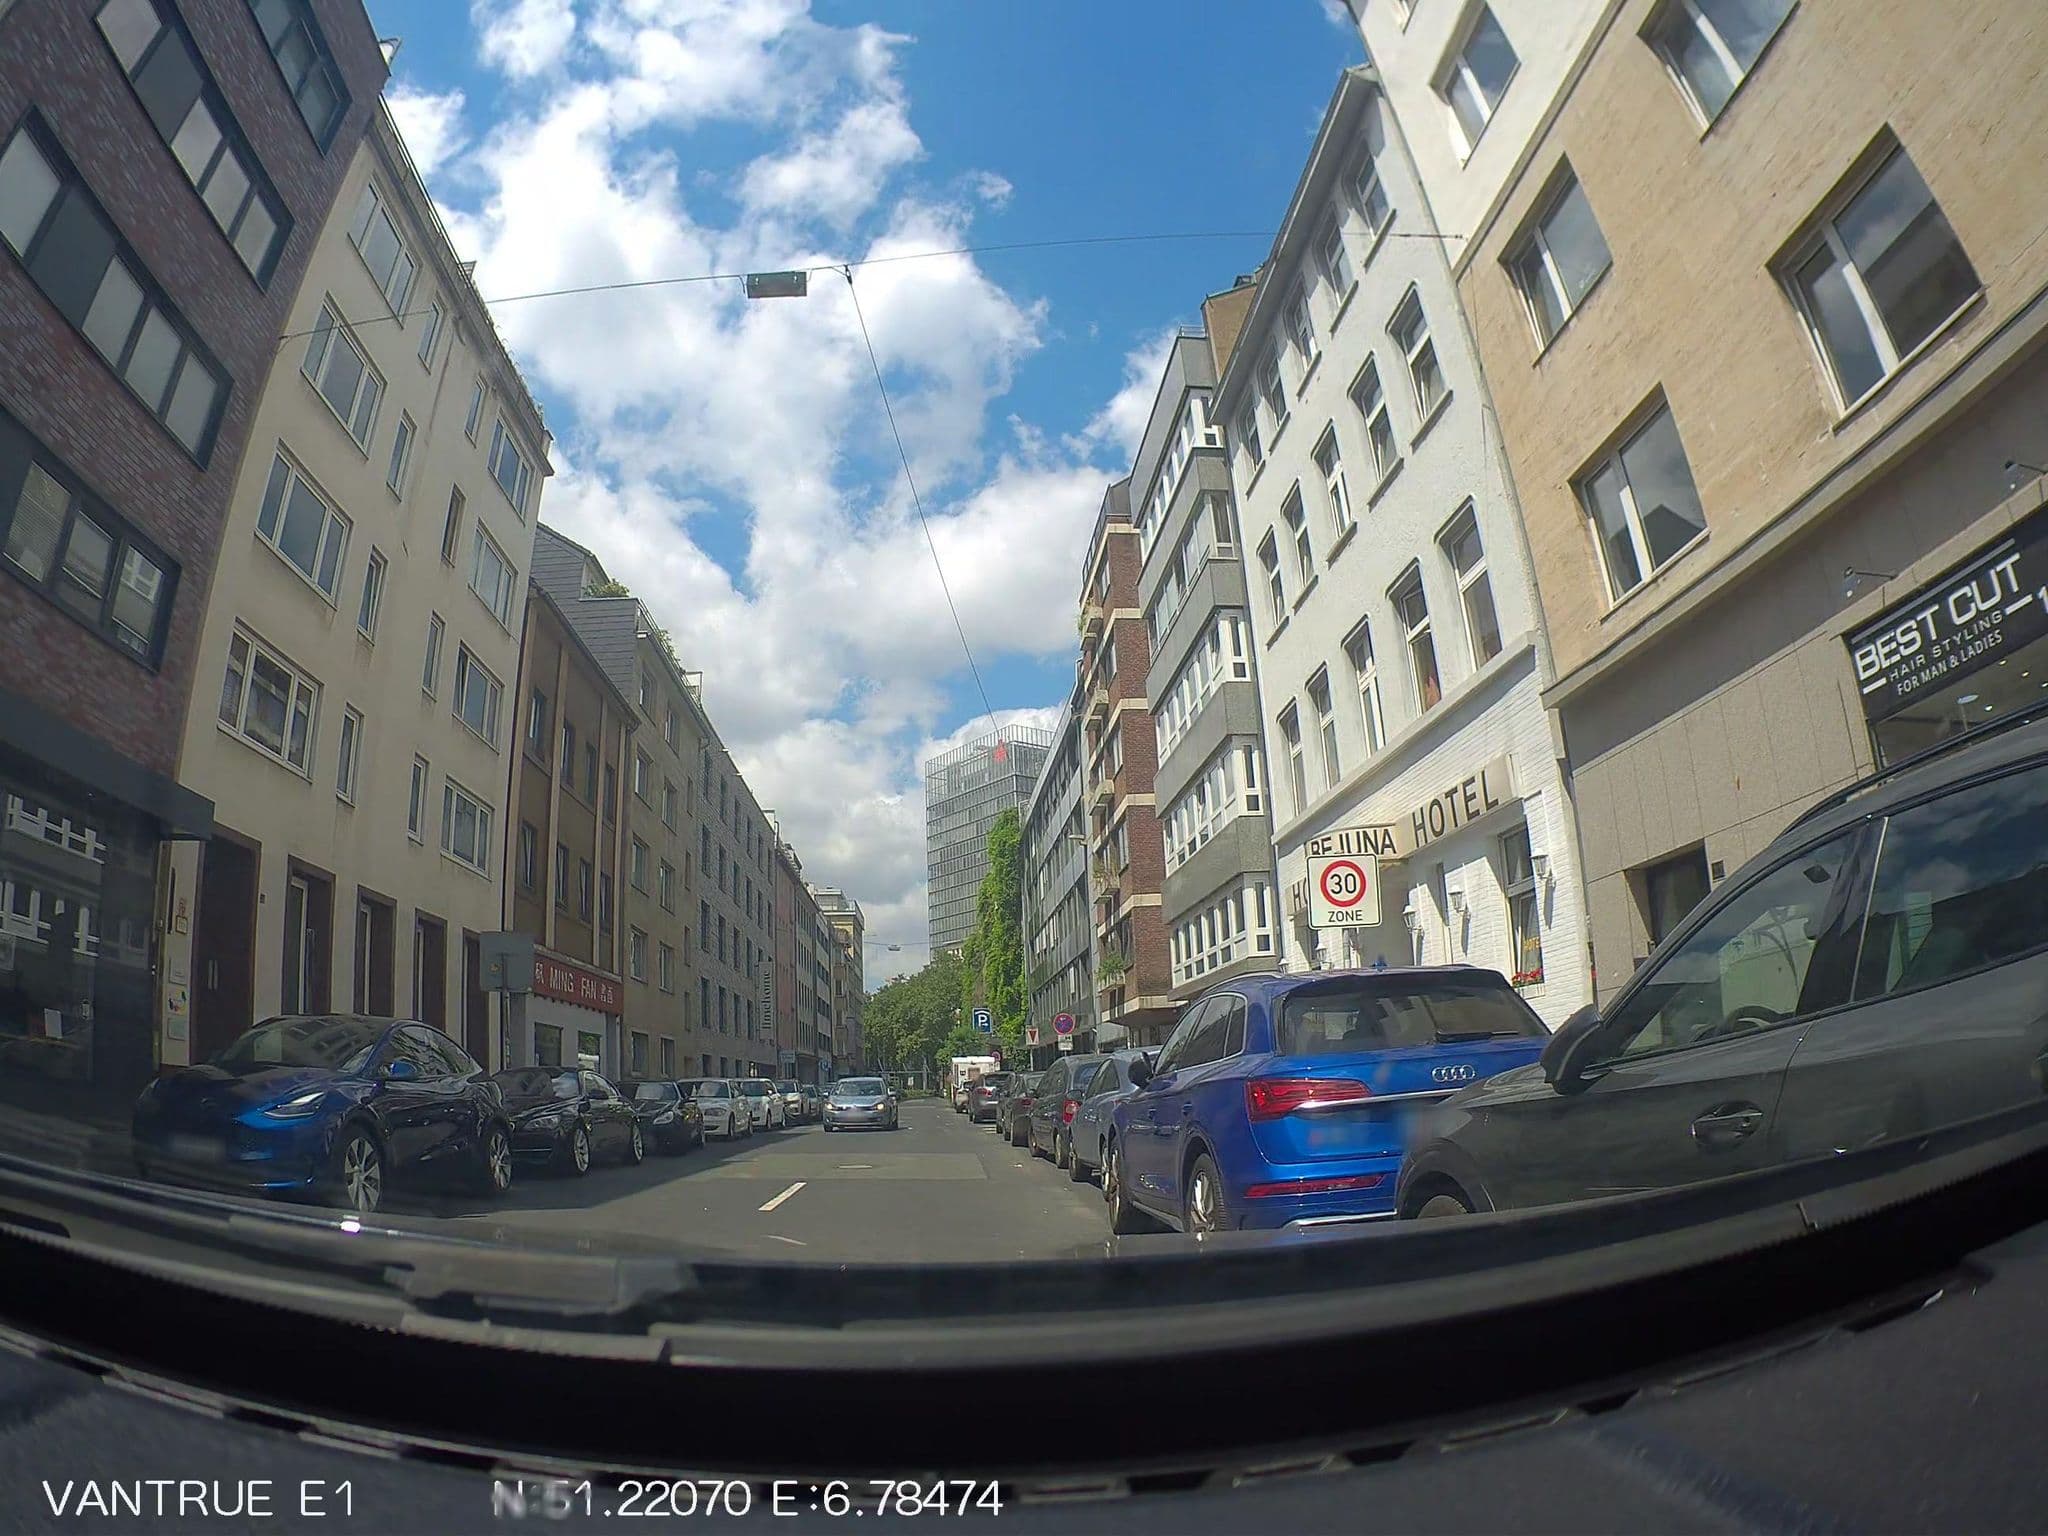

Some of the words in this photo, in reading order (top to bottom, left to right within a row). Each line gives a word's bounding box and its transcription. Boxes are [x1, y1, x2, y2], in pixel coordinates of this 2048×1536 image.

[1855, 604, 1939, 681] BEST
[1949, 552, 2020, 626] CUT
[1889, 654, 1926, 683] HAIR
[1933, 609, 2003, 658] STYLING
[1897, 676, 1920, 695] FOR
[1921, 661, 1947, 684] MAN
[1950, 654, 1960, 669] &
[1961, 629, 2003, 662] LADIES
[1412, 770, 1499, 848] HOTEL
[1328, 910, 1363, 923] ZONE
[1330, 873, 1357, 895] 30
[549, 967, 574, 993] MING
[581, 977, 597, 1000] FAN
